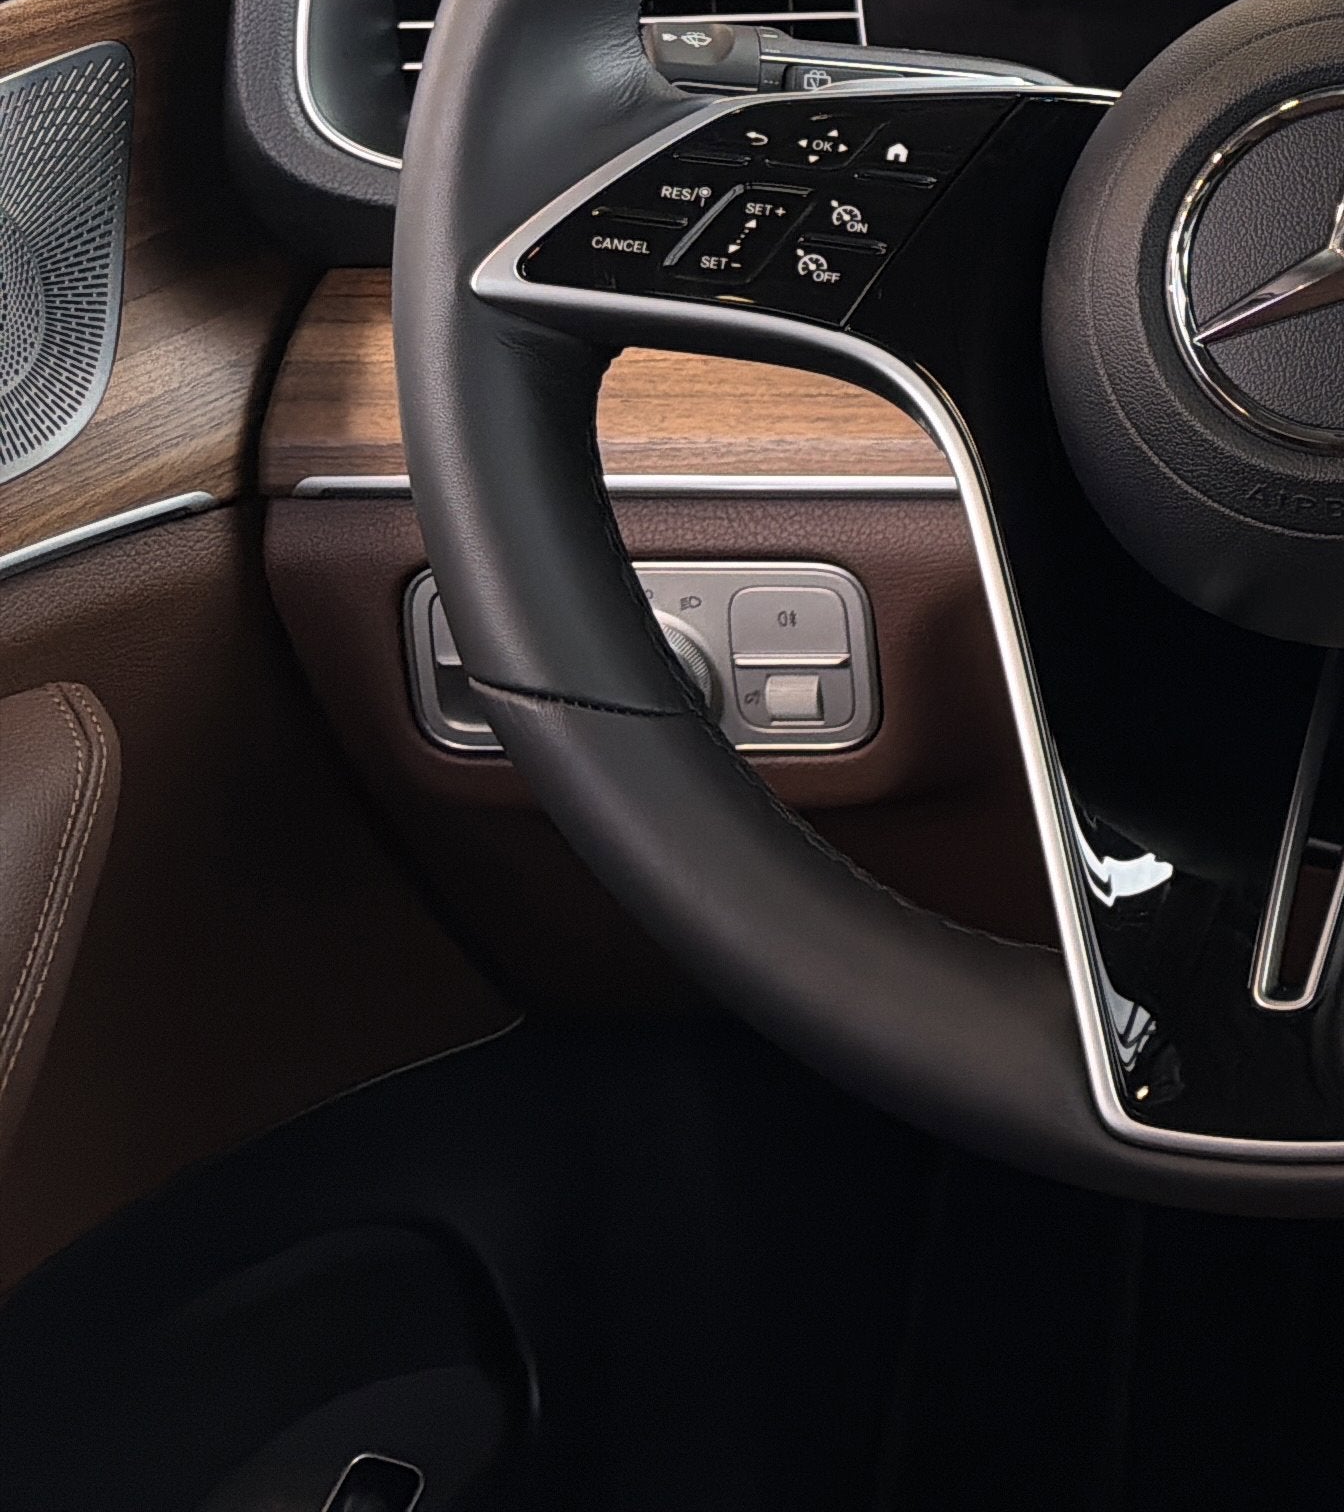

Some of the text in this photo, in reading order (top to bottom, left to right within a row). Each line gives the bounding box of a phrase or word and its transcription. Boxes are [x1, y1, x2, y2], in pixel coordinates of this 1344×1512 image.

[812, 139, 834, 153] OK
[745, 202, 772, 216] SET
[846, 221, 868, 233] ON
[591, 236, 651, 254] CANCEL
[700, 256, 728, 270] SET
[812, 270, 841, 284] OFF
